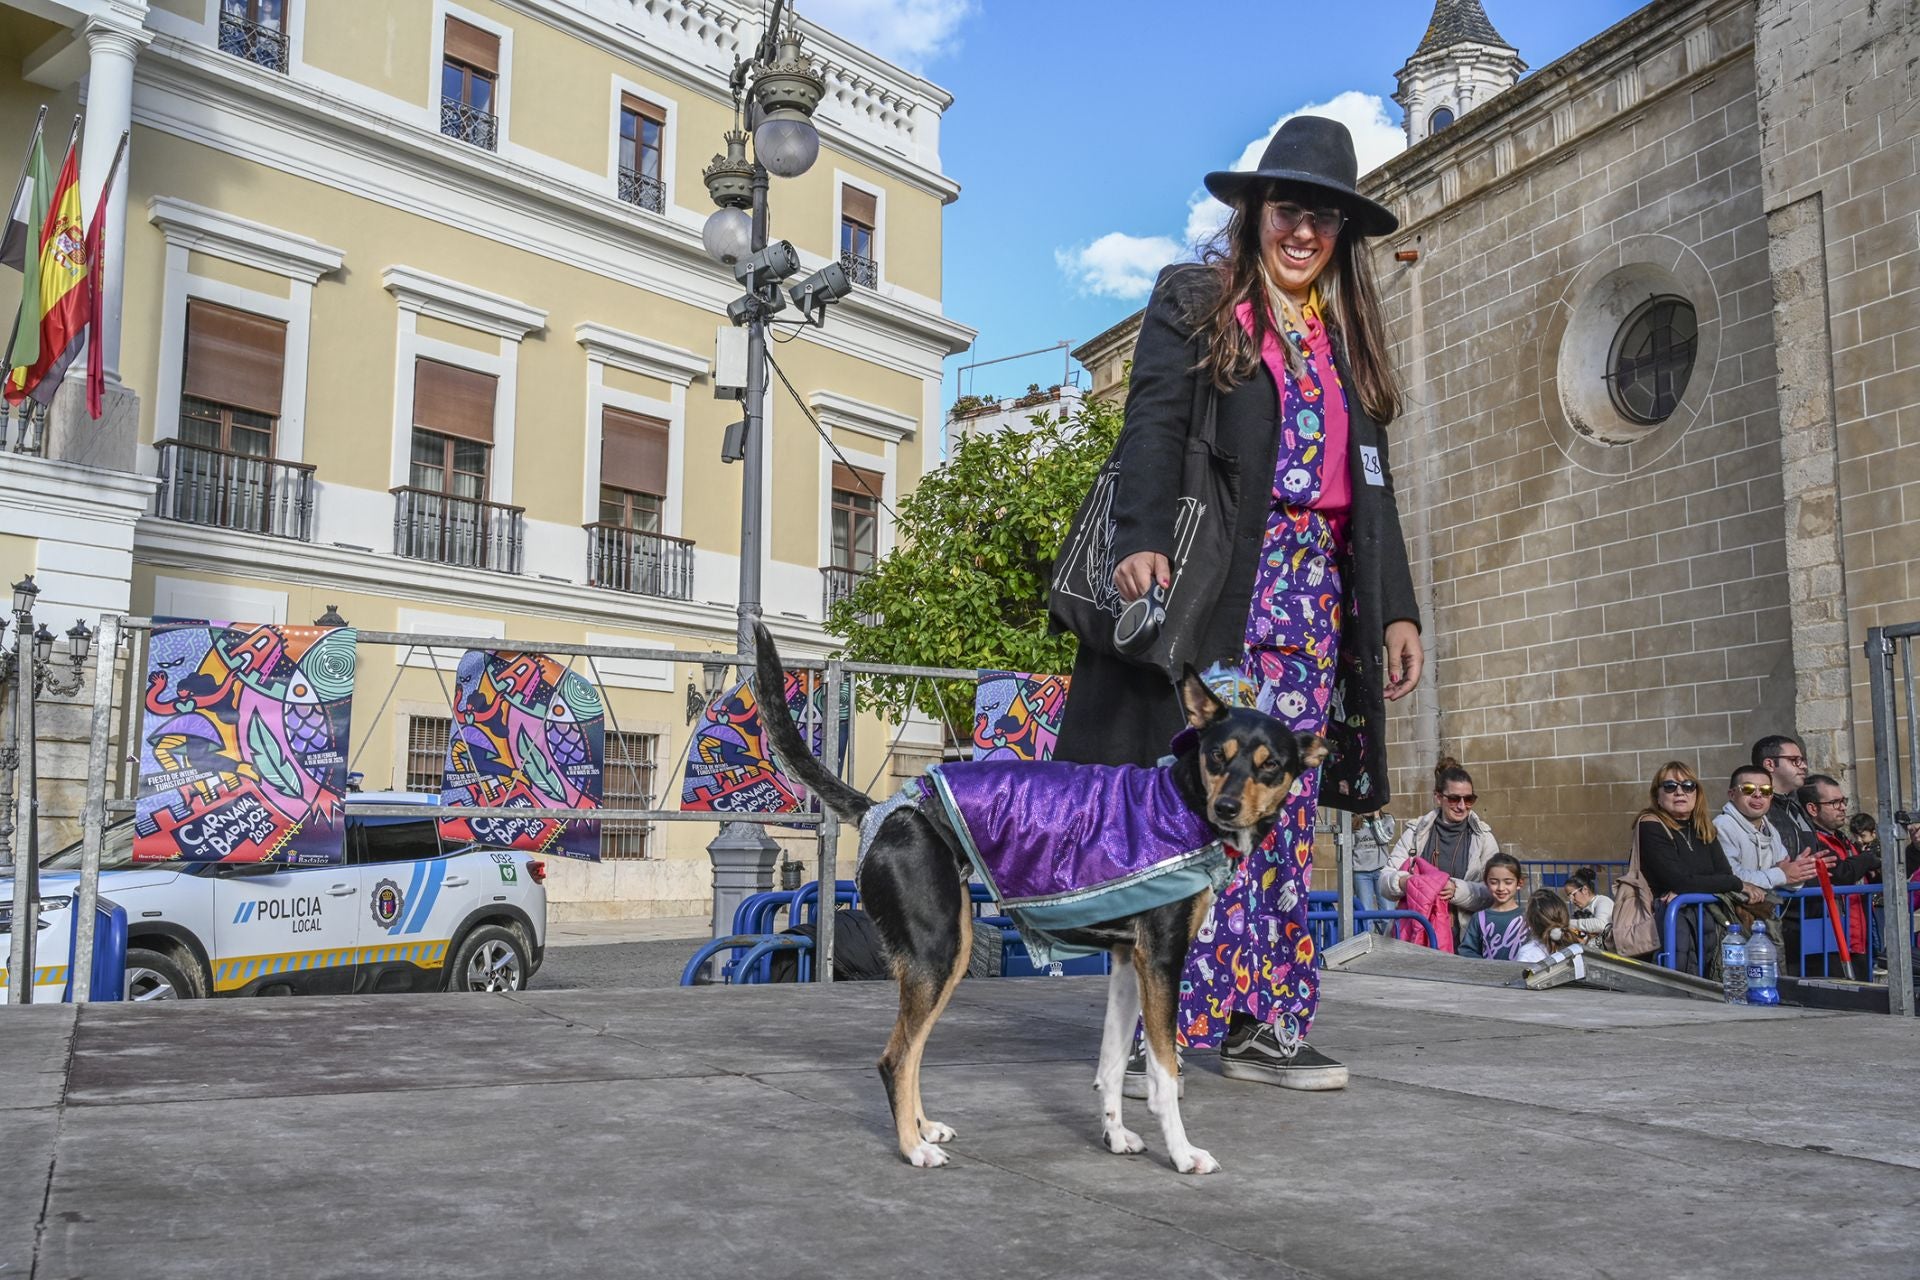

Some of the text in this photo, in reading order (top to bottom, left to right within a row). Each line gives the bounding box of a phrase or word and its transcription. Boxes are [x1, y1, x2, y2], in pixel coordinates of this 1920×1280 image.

[1363, 453, 1381, 475] 28
[147, 774, 171, 786] FIESTA
[171, 772, 179, 780] DE
[714, 781, 773, 811] CARNAVAL
[765, 799, 784, 813] 2025
[179, 797, 259, 845] CARNAVAL
[524, 819, 544, 838] 2025
[194, 807, 268, 856] DE BADAJOZ
[248, 820, 274, 845] 2025
[485, 833, 496, 842] DE
[490, 854, 515, 863] 092
[258, 897, 322, 920] POLICIA
[292, 918, 322, 933] LOCAL
